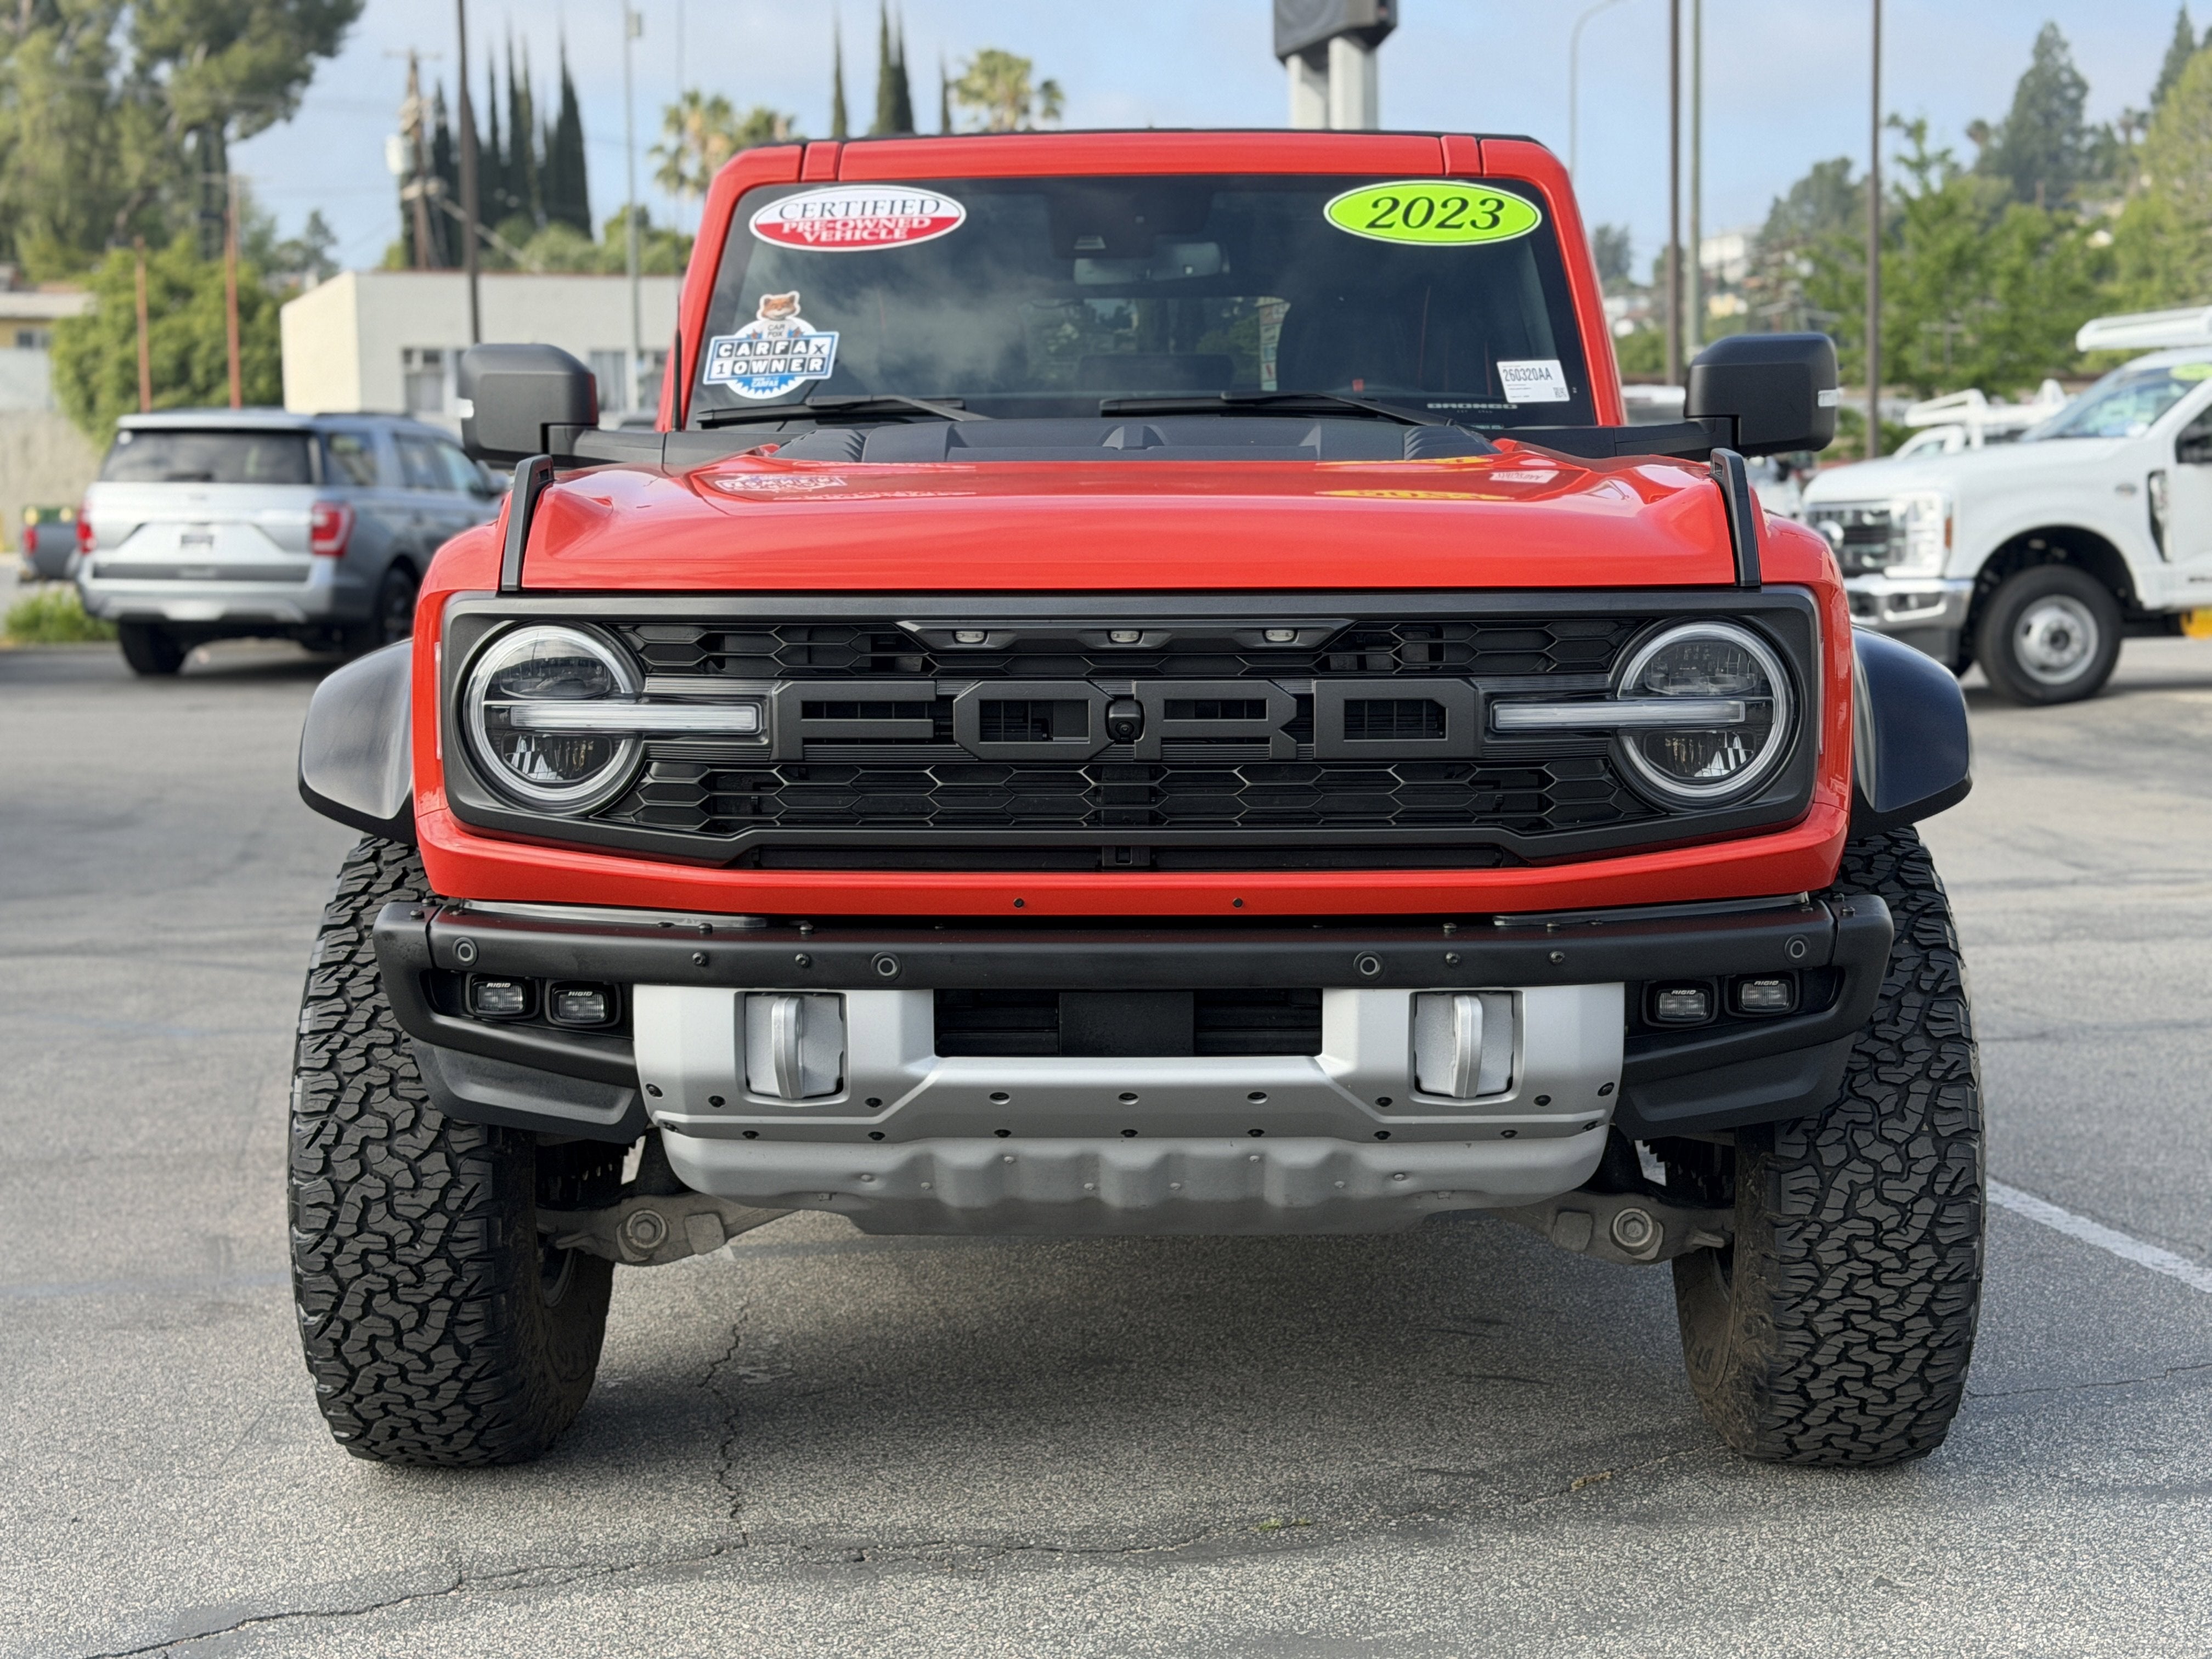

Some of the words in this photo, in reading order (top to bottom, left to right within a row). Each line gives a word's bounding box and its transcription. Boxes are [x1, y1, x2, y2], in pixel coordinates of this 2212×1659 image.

[778, 199, 940, 220] CERTIFIED
[1365, 196, 1505, 230] 2023
[781, 217, 932, 234] PRE-OWNED
[802, 228, 907, 243] VEHICLE
[718, 340, 826, 358] CARFAX
[716, 362, 725, 375] 1
[733, 358, 823, 375] OWNER
[1503, 368, 1553, 382] 260320AA
[771, 679, 1479, 761] FORD
